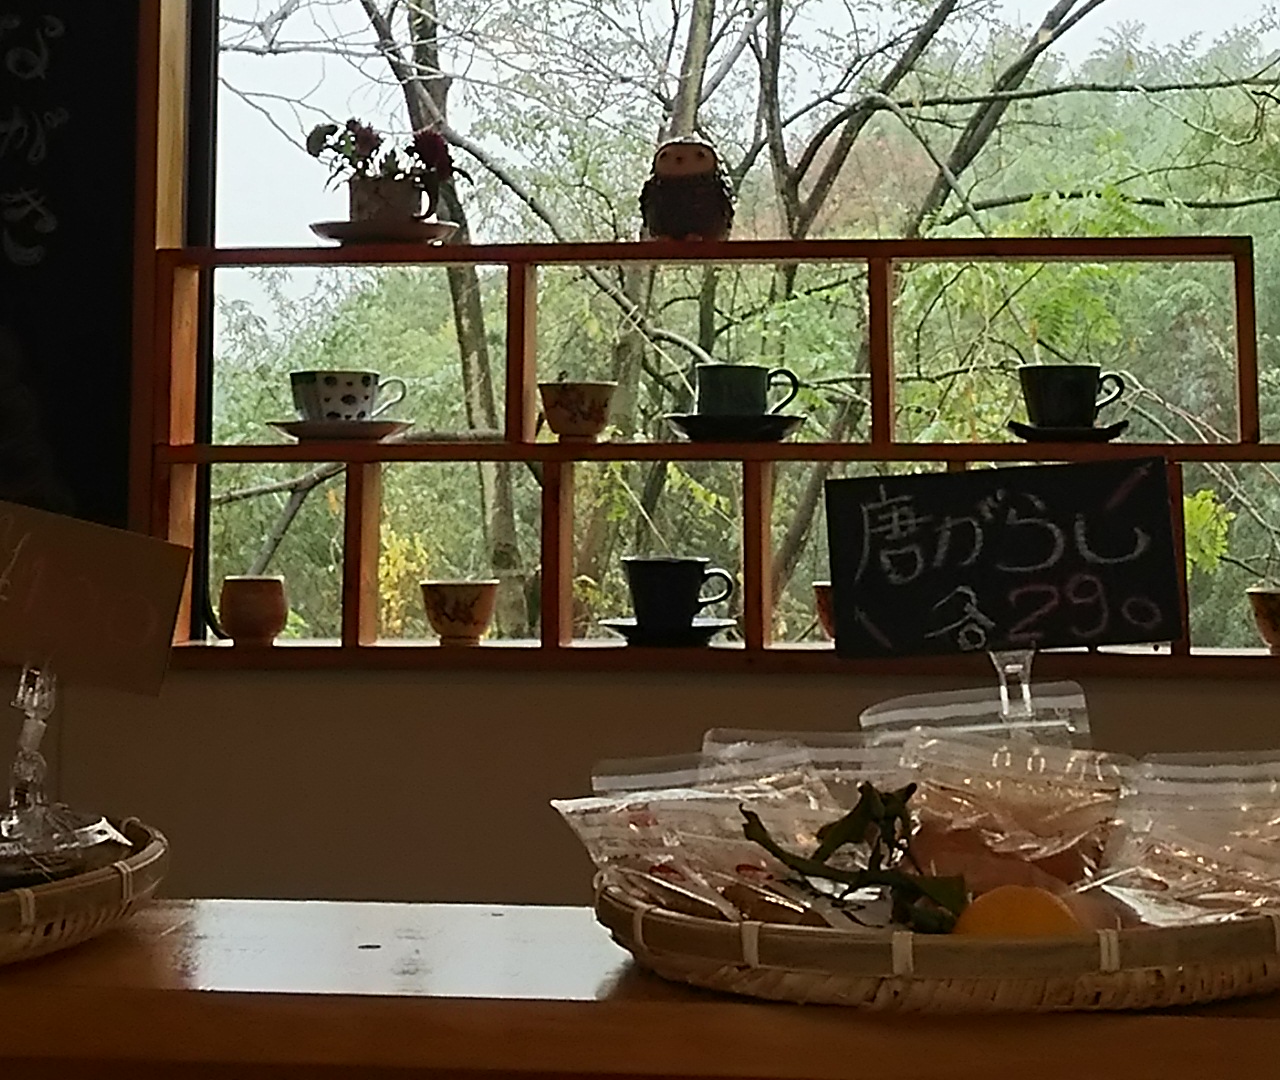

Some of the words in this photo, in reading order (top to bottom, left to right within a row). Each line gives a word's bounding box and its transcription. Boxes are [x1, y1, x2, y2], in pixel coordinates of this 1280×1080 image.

[854, 483, 1152, 586] 唐がらし
[1006, 572, 1163, 643] 290
